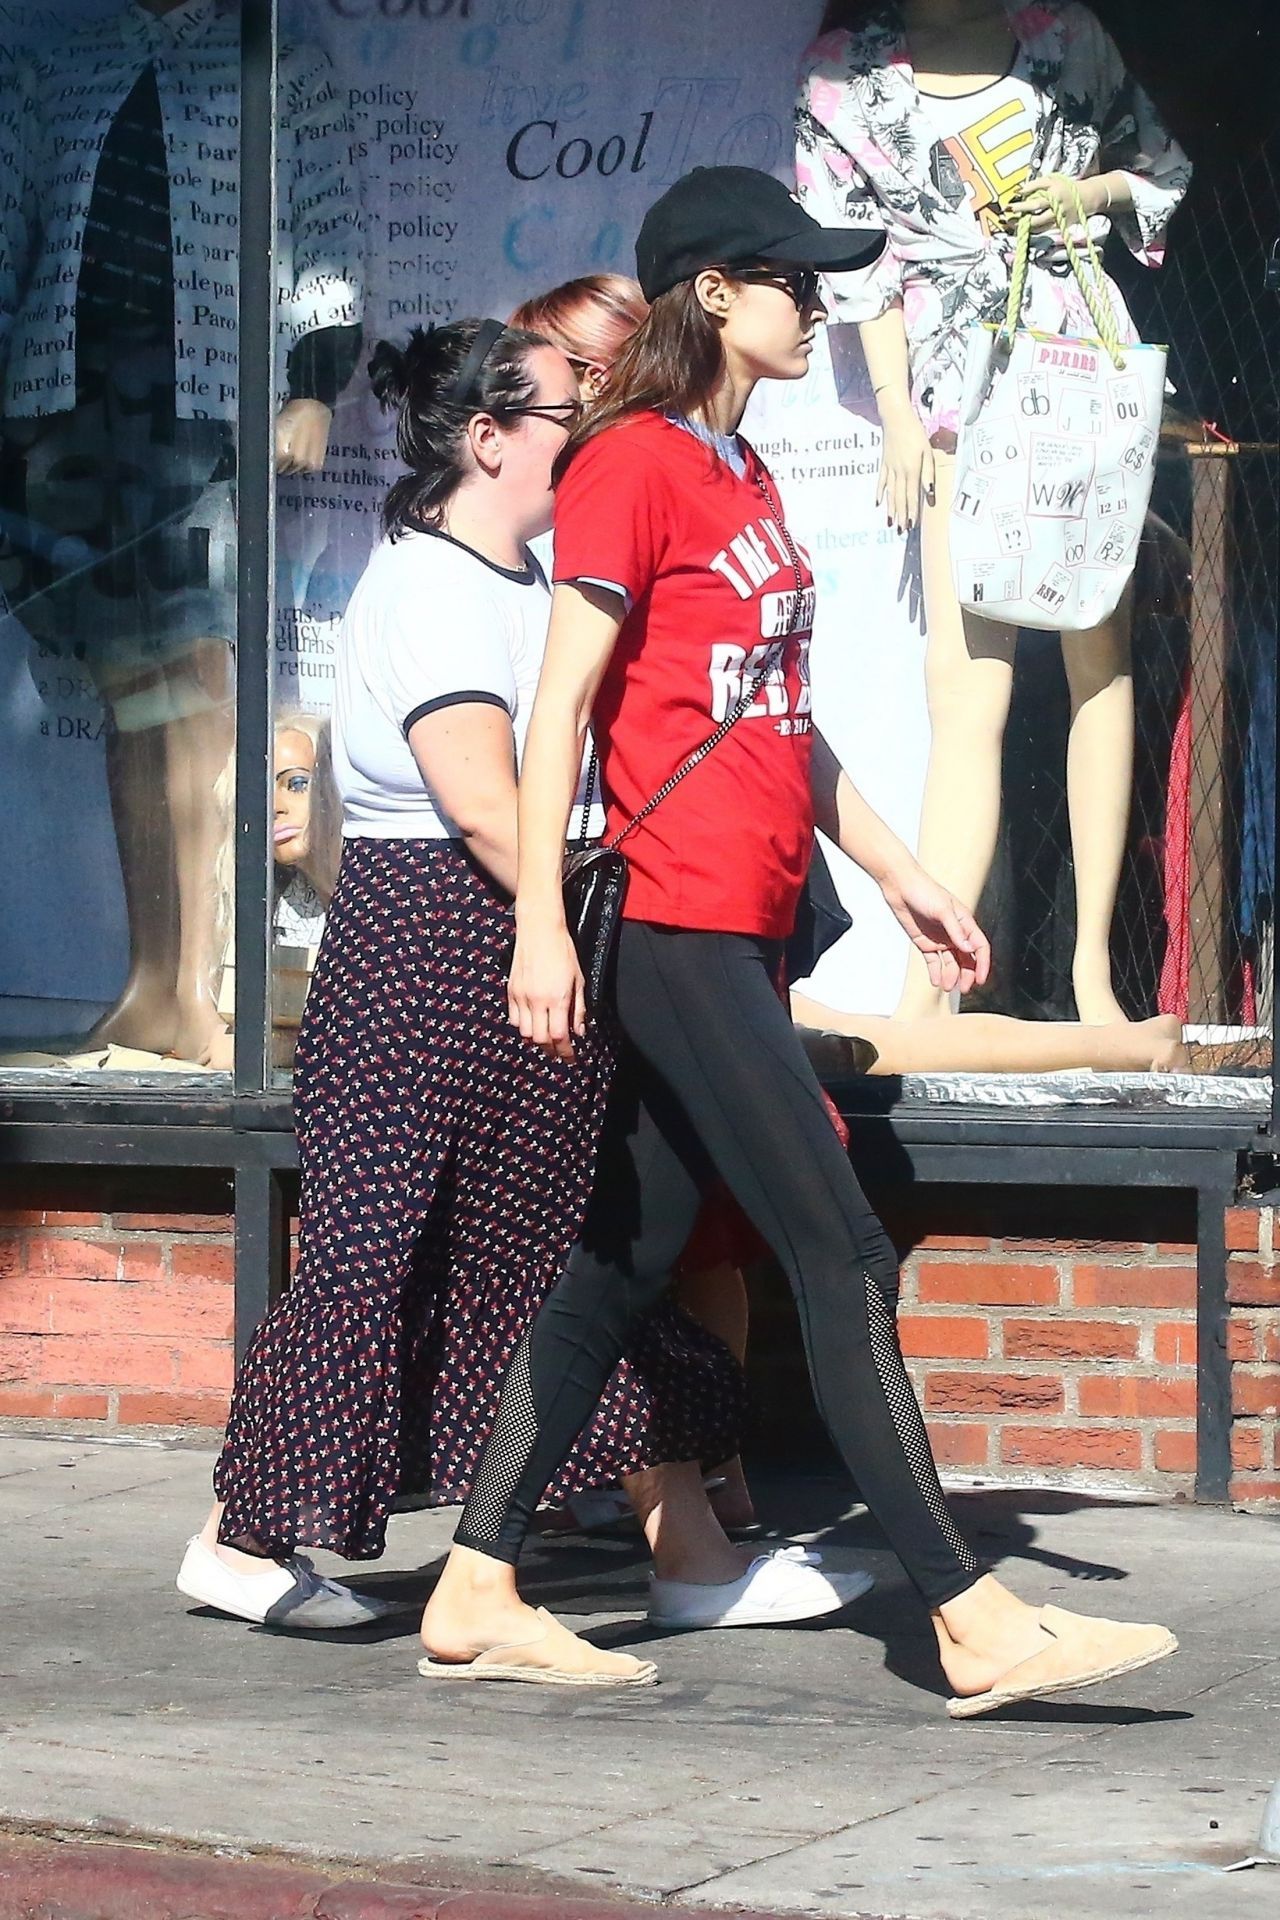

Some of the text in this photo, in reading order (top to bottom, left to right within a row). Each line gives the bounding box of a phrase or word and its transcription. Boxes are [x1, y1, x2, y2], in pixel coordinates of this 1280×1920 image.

[348, 84, 418, 111] policy
[377, 114, 445, 143] policy
[391, 138, 458, 166] policy
[506, 111, 654, 182] Cool
[388, 215, 458, 243] policy
[388, 254, 458, 281] policy
[388, 293, 458, 321] policy
[321, 469, 390, 488] ruthless,
[791, 457, 880, 484] tyrannical
